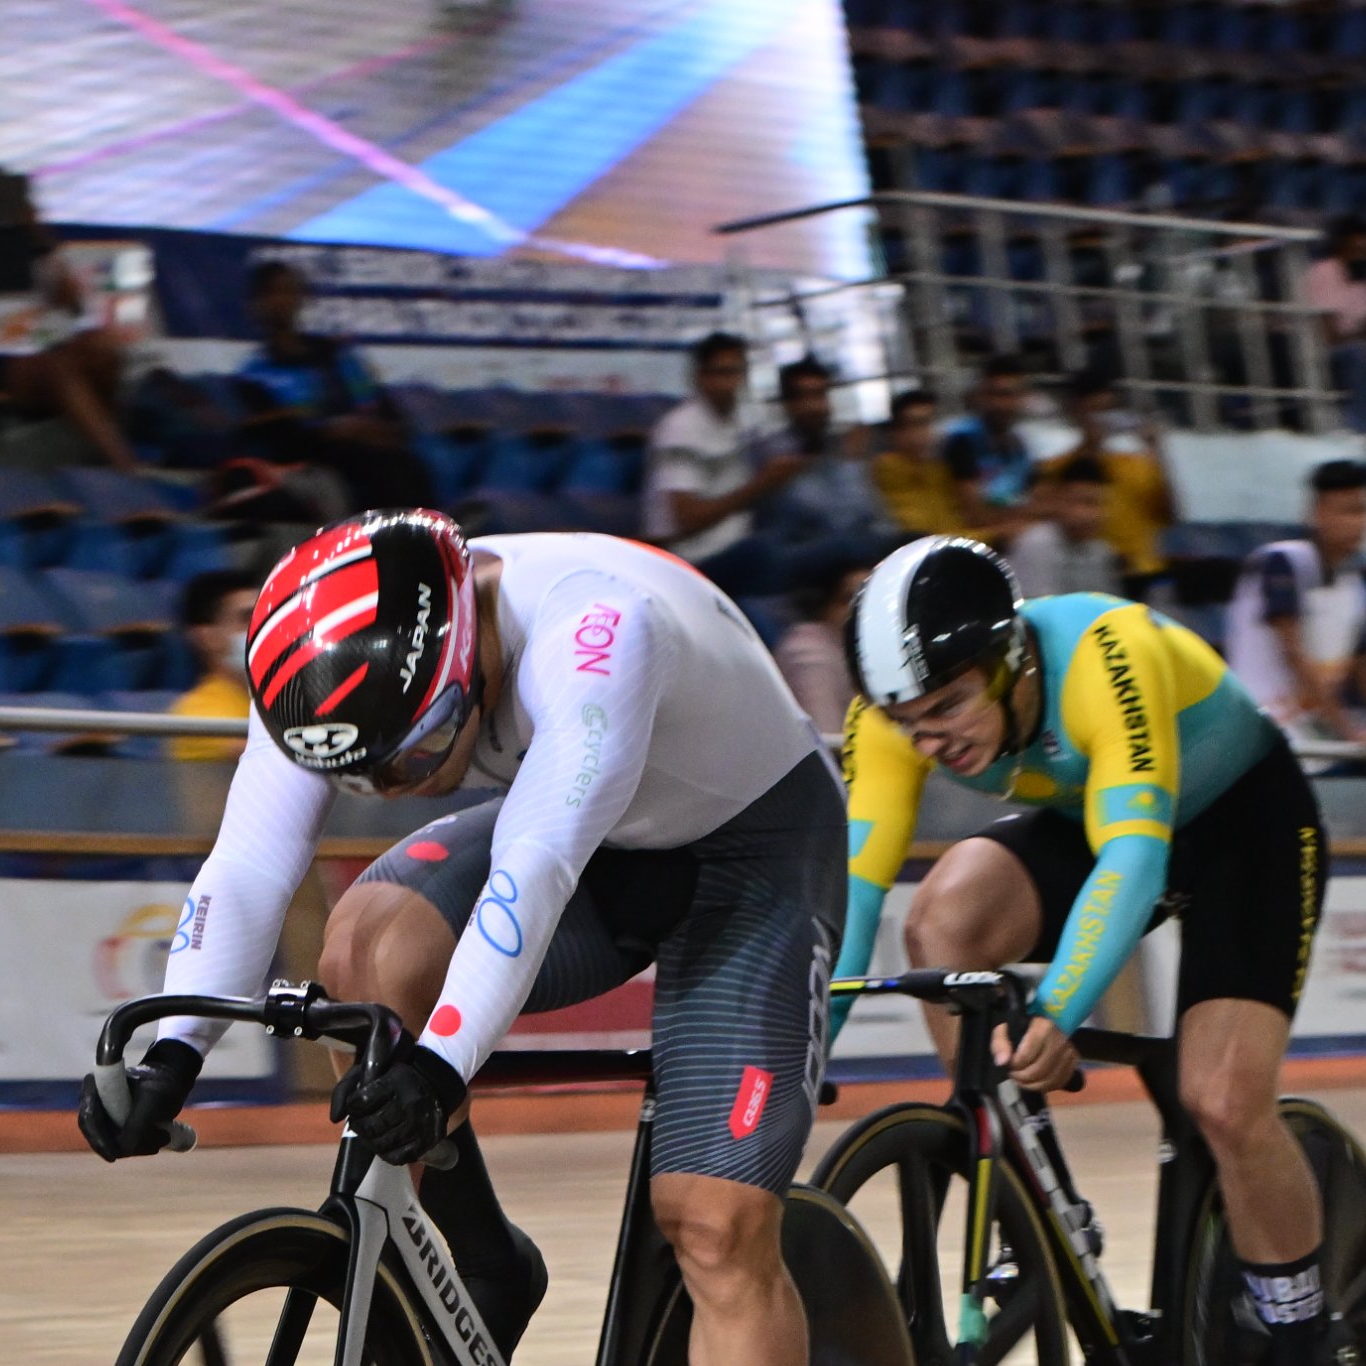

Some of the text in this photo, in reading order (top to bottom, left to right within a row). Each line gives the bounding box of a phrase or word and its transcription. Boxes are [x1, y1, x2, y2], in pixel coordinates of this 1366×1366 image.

[400, 582, 431, 694] JAPAN
[1094, 624, 1157, 773] KAZAKHSTAN
[191, 895, 212, 950] KEIRIN
